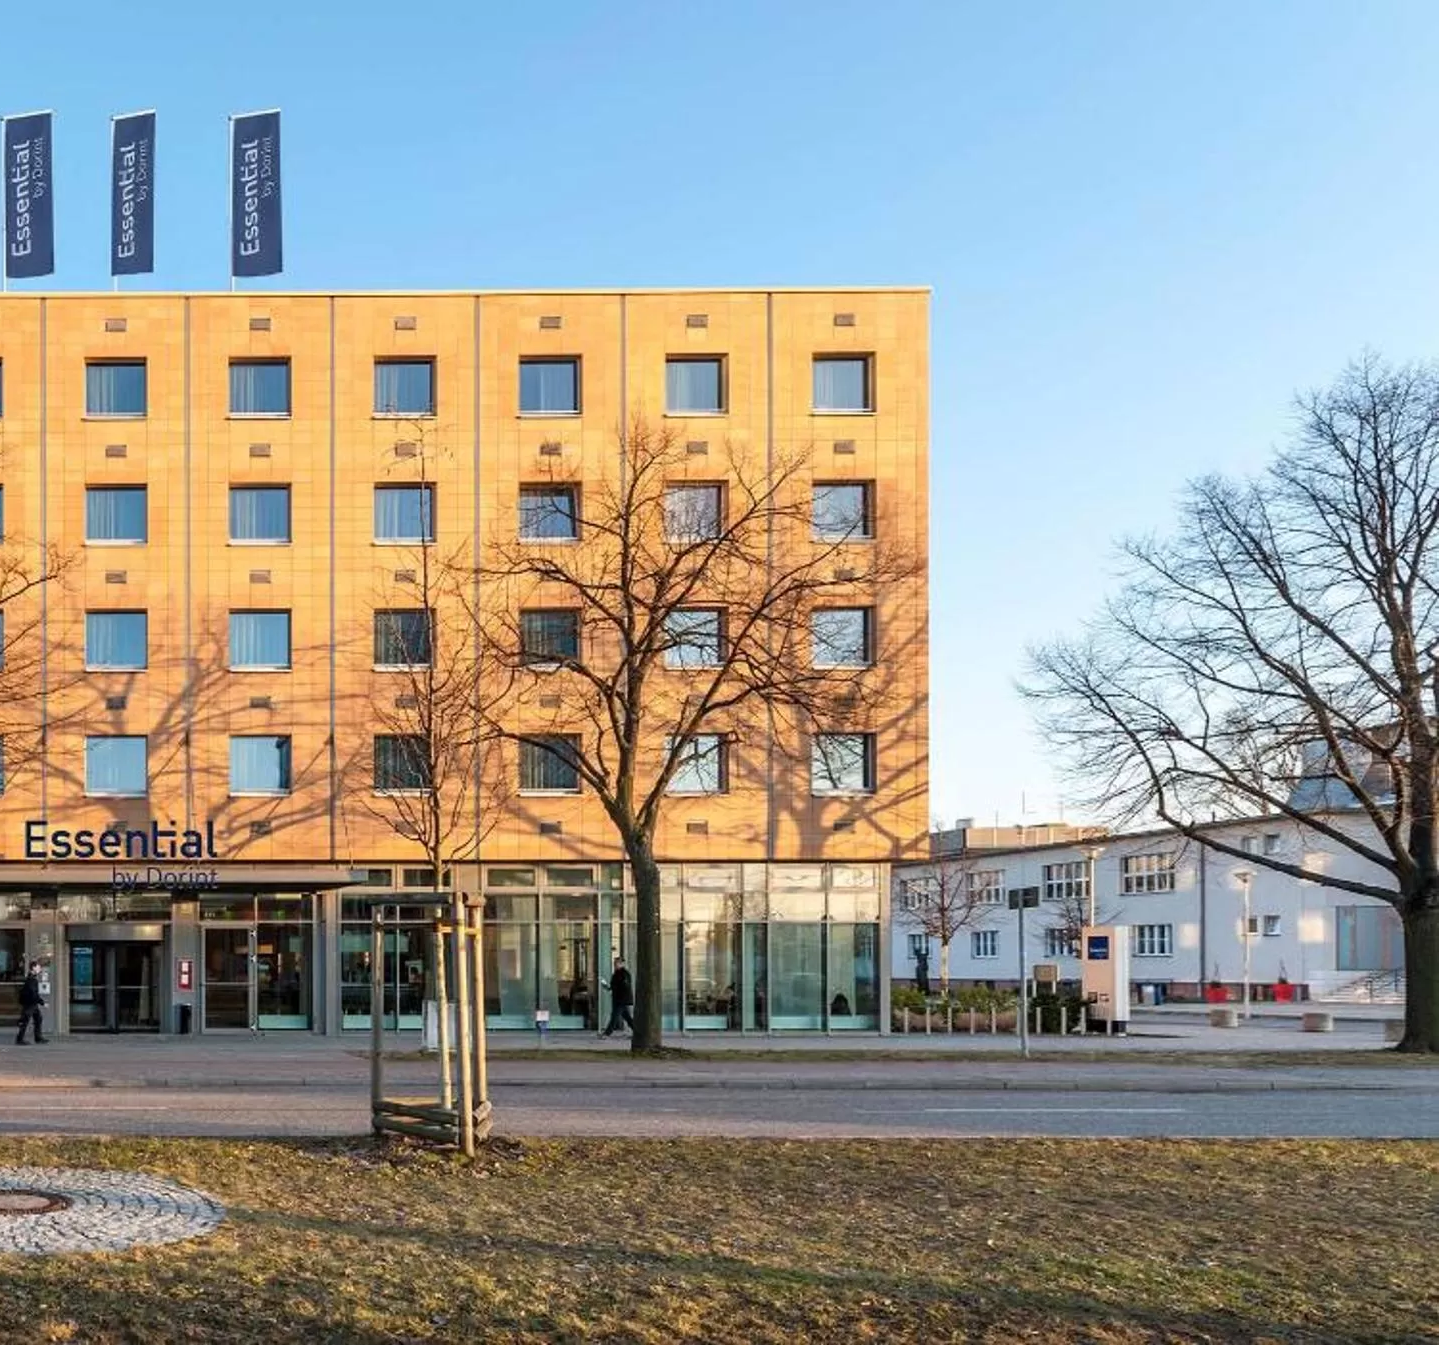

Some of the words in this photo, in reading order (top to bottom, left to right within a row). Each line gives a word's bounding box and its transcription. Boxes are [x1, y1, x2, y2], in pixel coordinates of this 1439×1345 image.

[11, 139, 32, 257] Essential
[33, 181, 46, 199] by
[118, 141, 136, 258] Essential
[136, 185, 149, 202] by
[241, 139, 259, 256] Essential
[261, 181, 274, 198] by
[25, 820, 218, 858] Essential
[112, 866, 138, 891] by
[147, 866, 219, 889] Dorint
